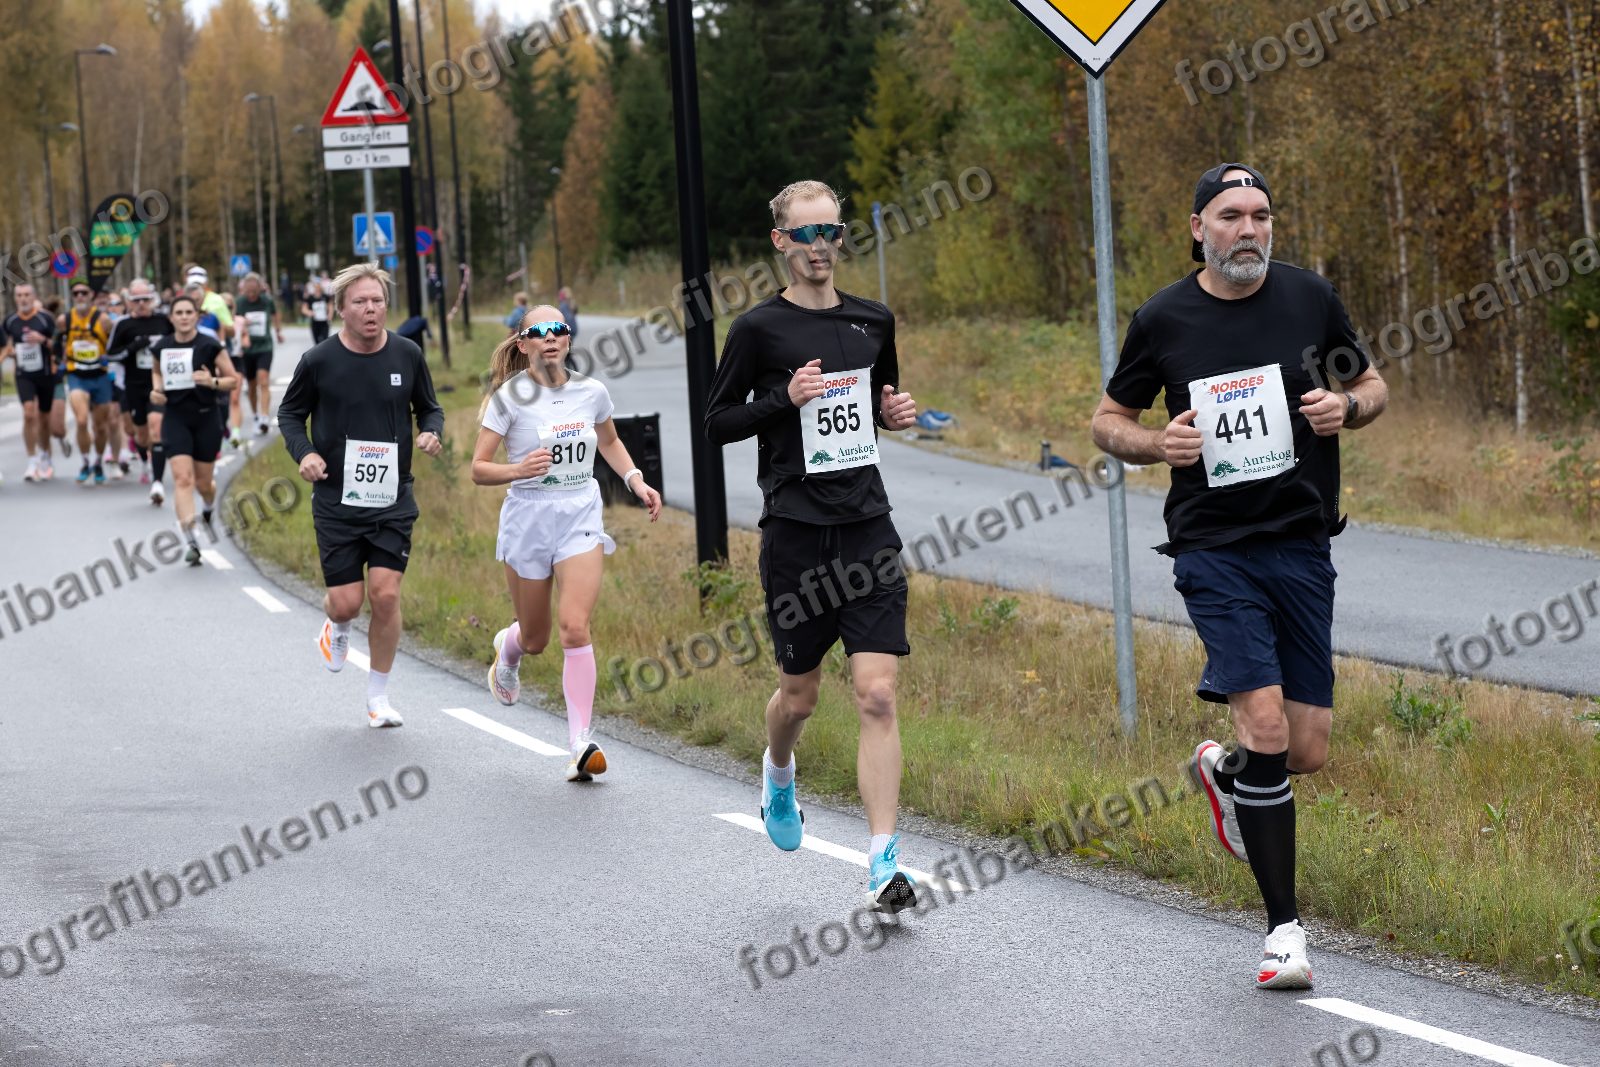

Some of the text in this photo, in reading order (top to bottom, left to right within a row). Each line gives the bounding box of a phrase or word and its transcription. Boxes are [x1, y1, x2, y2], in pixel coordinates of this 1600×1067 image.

[340, 130, 391, 144] Gangfelt
[372, 152, 391, 164] km
[821, 376, 858, 390] ORGES
[1210, 374, 1265, 395] NORGES
[1216, 386, 1257, 404] LØPET
[817, 403, 861, 436] 565
[1215, 404, 1269, 444] 441
[552, 421, 585, 433] NORGES
[556, 429, 582, 439] LØPET
[358, 445, 390, 454] NORGES
[551, 441, 587, 465] 810
[837, 443, 875, 458] Aurskog
[1242, 449, 1292, 468] Aurskog
[354, 463, 389, 484] 597
[1244, 461, 1286, 475] SPAREBANK
[364, 491, 395, 501] Aurskog
